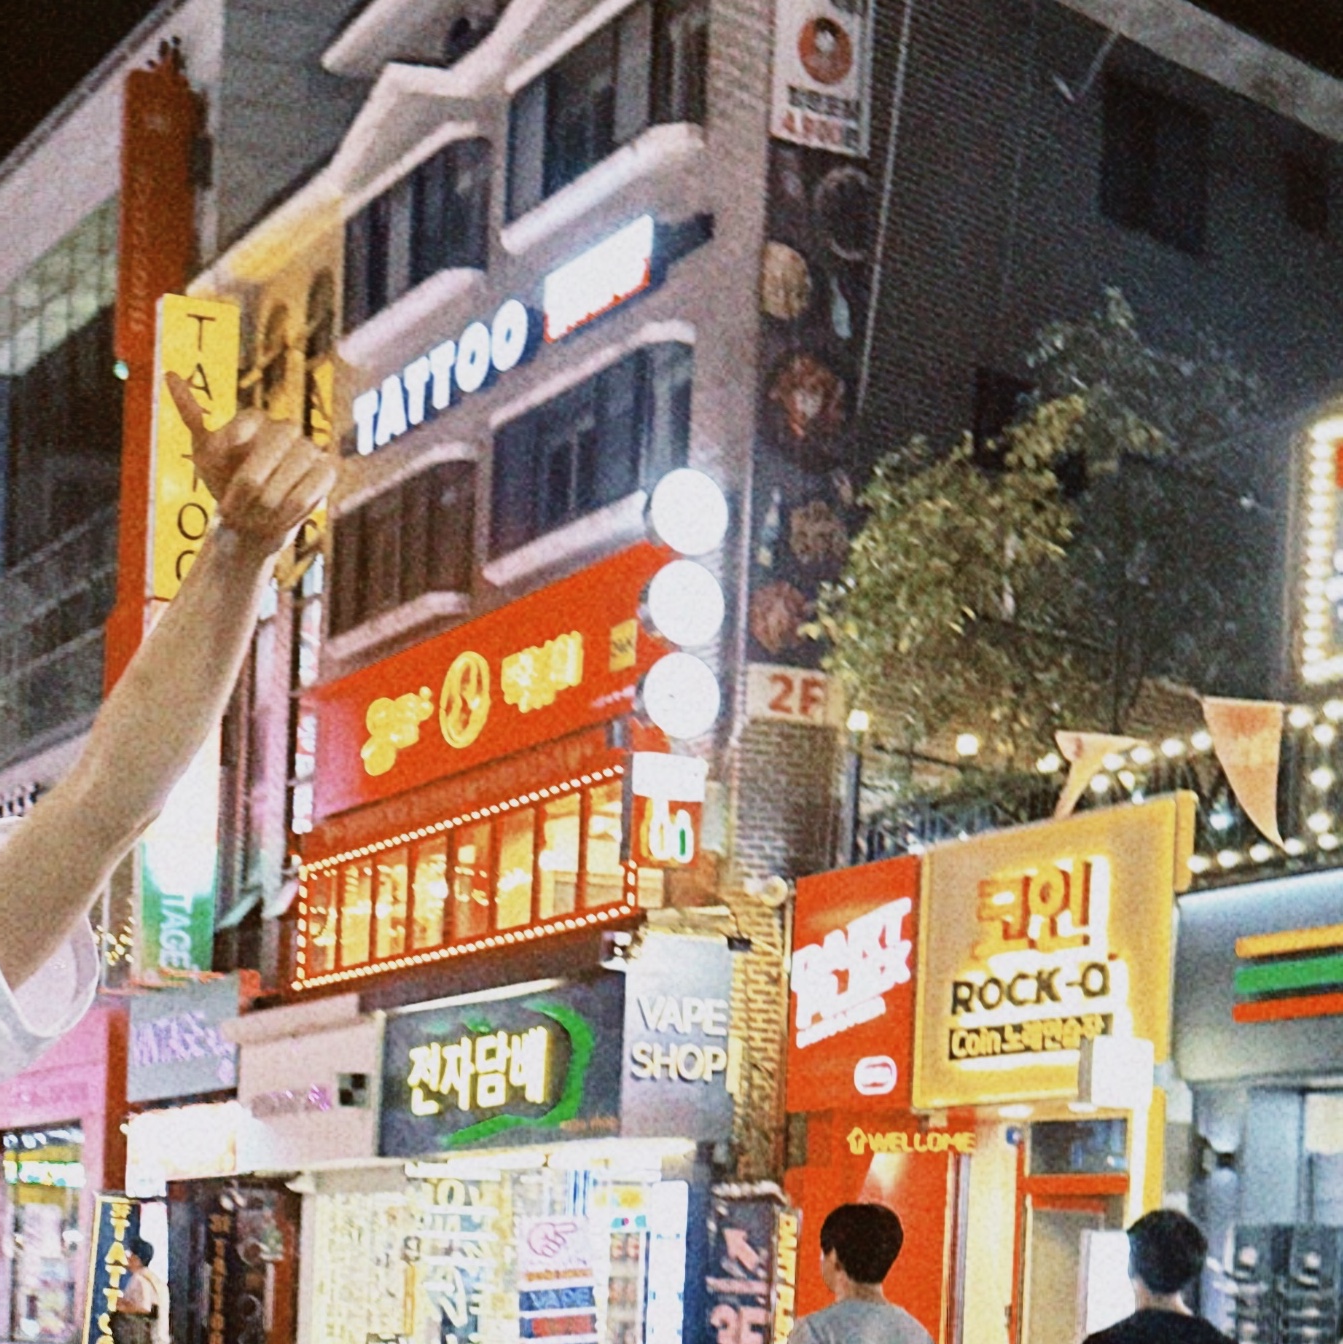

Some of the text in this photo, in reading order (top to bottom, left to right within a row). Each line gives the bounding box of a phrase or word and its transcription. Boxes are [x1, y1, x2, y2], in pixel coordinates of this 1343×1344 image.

[353, 299, 528, 455] TATTOO
[177, 313, 217, 581] TATO
[769, 673, 825, 716] 2F
[637, 997, 728, 1037] VAPE
[407, 1025, 549, 1117] 전자담배
[630, 1041, 727, 1082] SHOP
